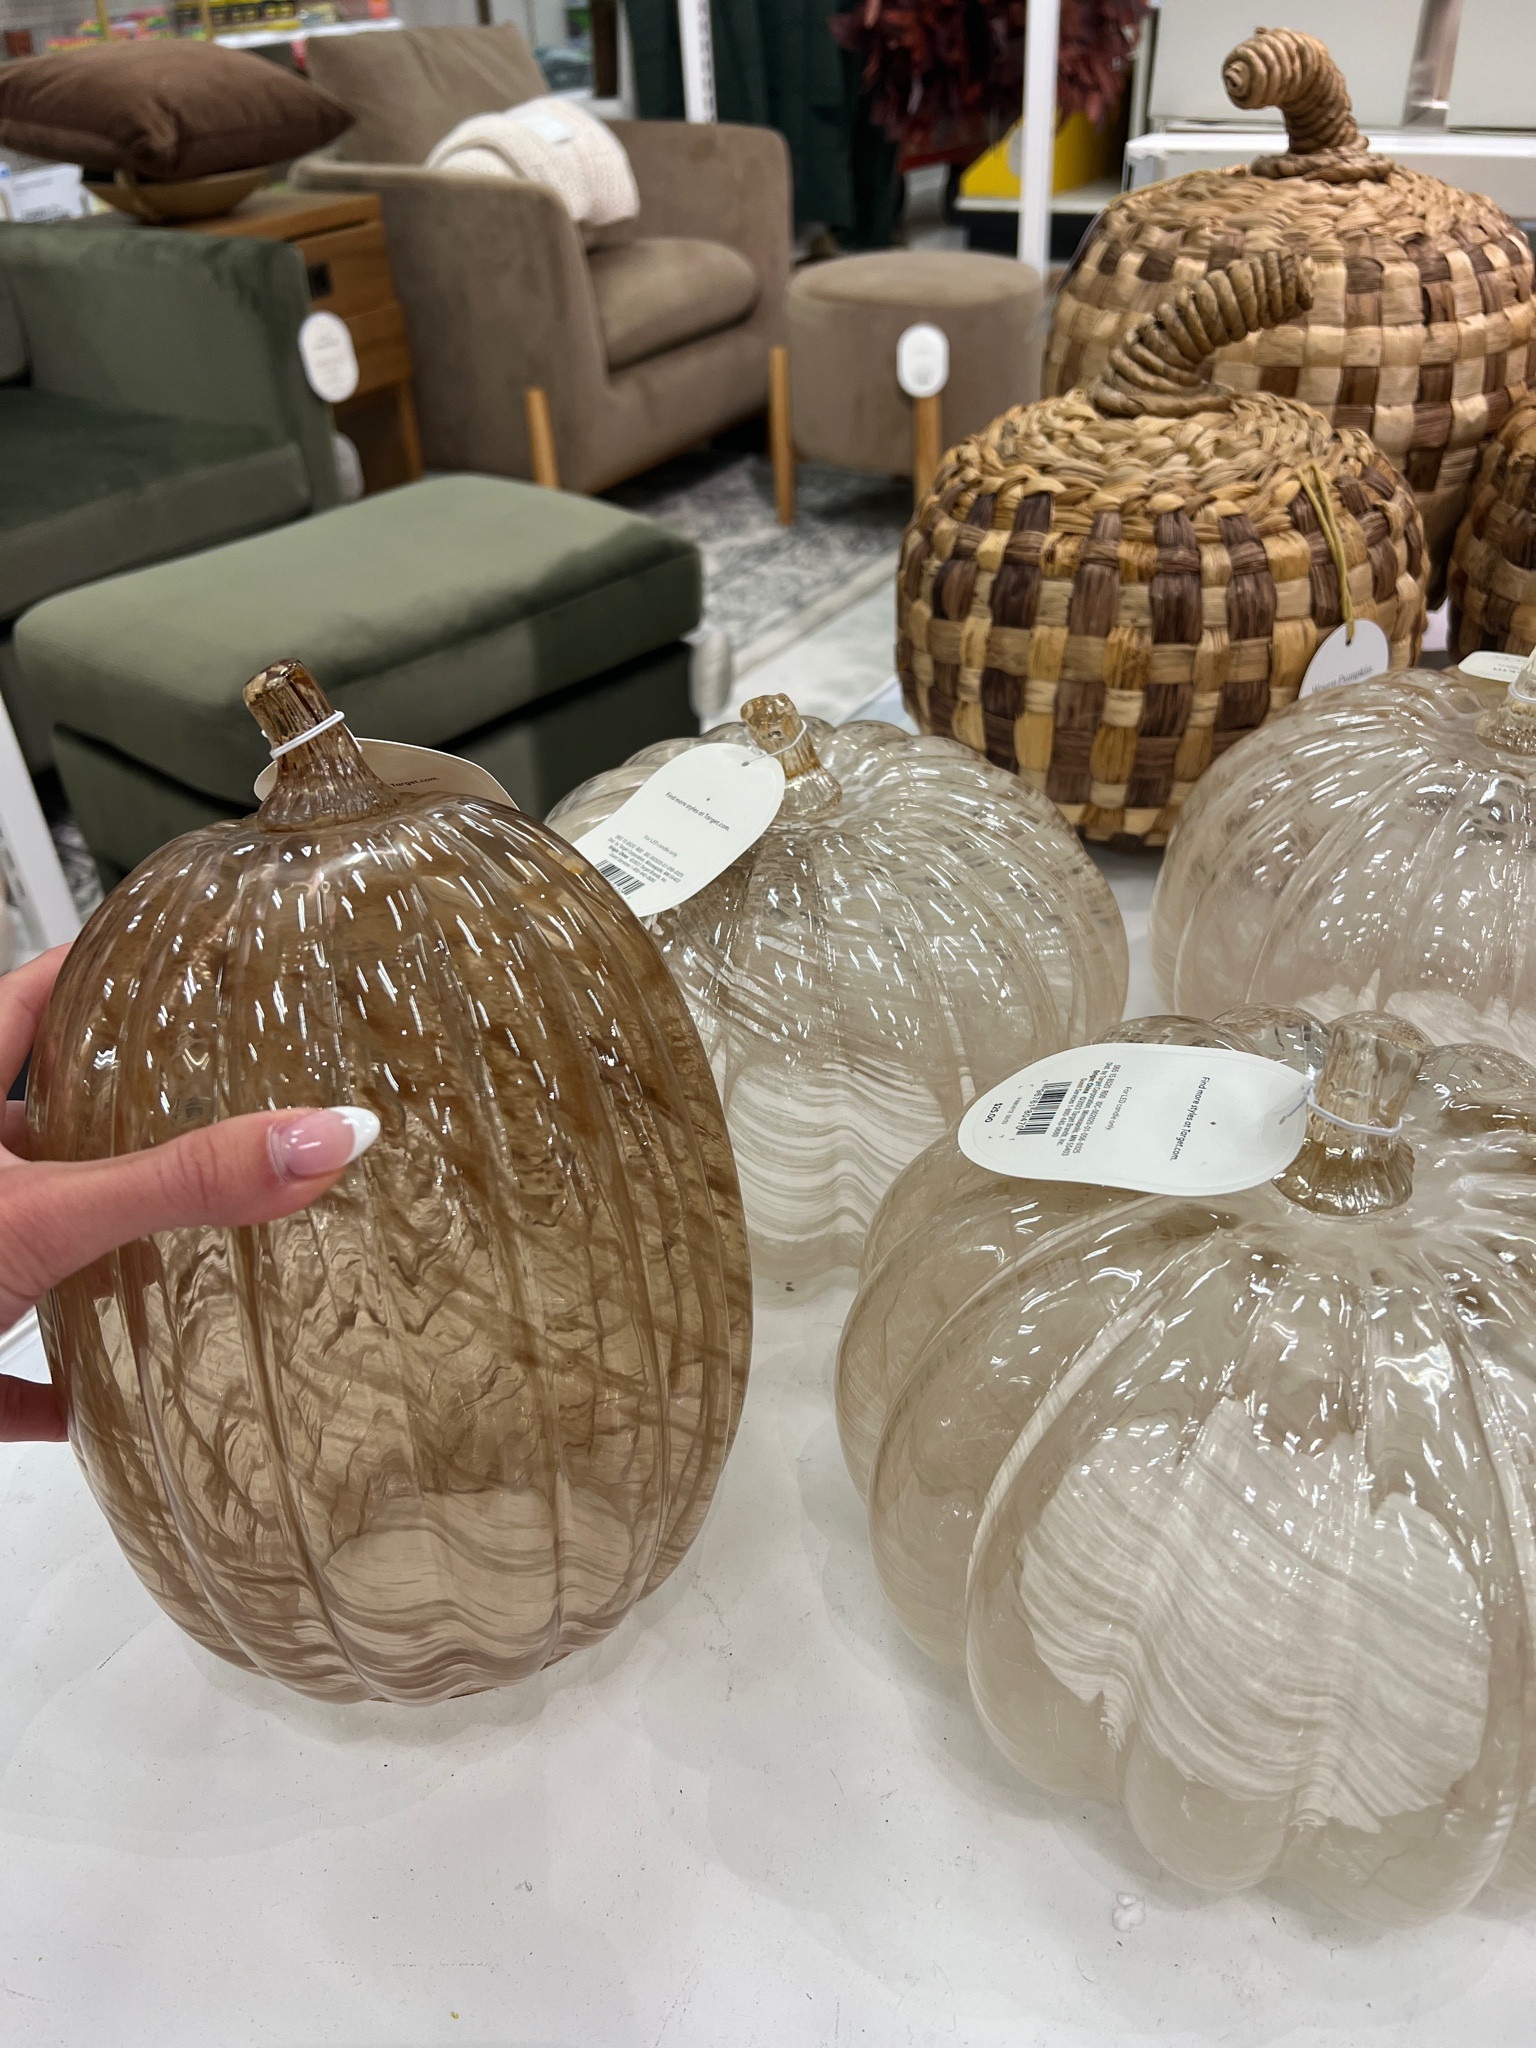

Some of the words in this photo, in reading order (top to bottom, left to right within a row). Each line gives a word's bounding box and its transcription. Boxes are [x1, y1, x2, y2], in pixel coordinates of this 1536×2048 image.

[665, 792, 677, 800] Find
[674, 798, 687, 807] more
[685, 804, 699, 814] styles
[1082, 1081, 1094, 1094] China
[1095, 1073, 1107, 1087] Target
[1198, 1076, 1211, 1090] Find
[1068, 1087, 1082, 1104] Services
[1122, 1086, 1132, 1094] For
[1192, 1089, 1204, 1105] more
[1118, 1094, 1128, 1104] LED
[984, 1102, 1004, 1123] $25.00
[1068, 1108, 1080, 1123] Target
[1110, 1104, 1123, 1120] candle
[1186, 1104, 1198, 1121] styles
